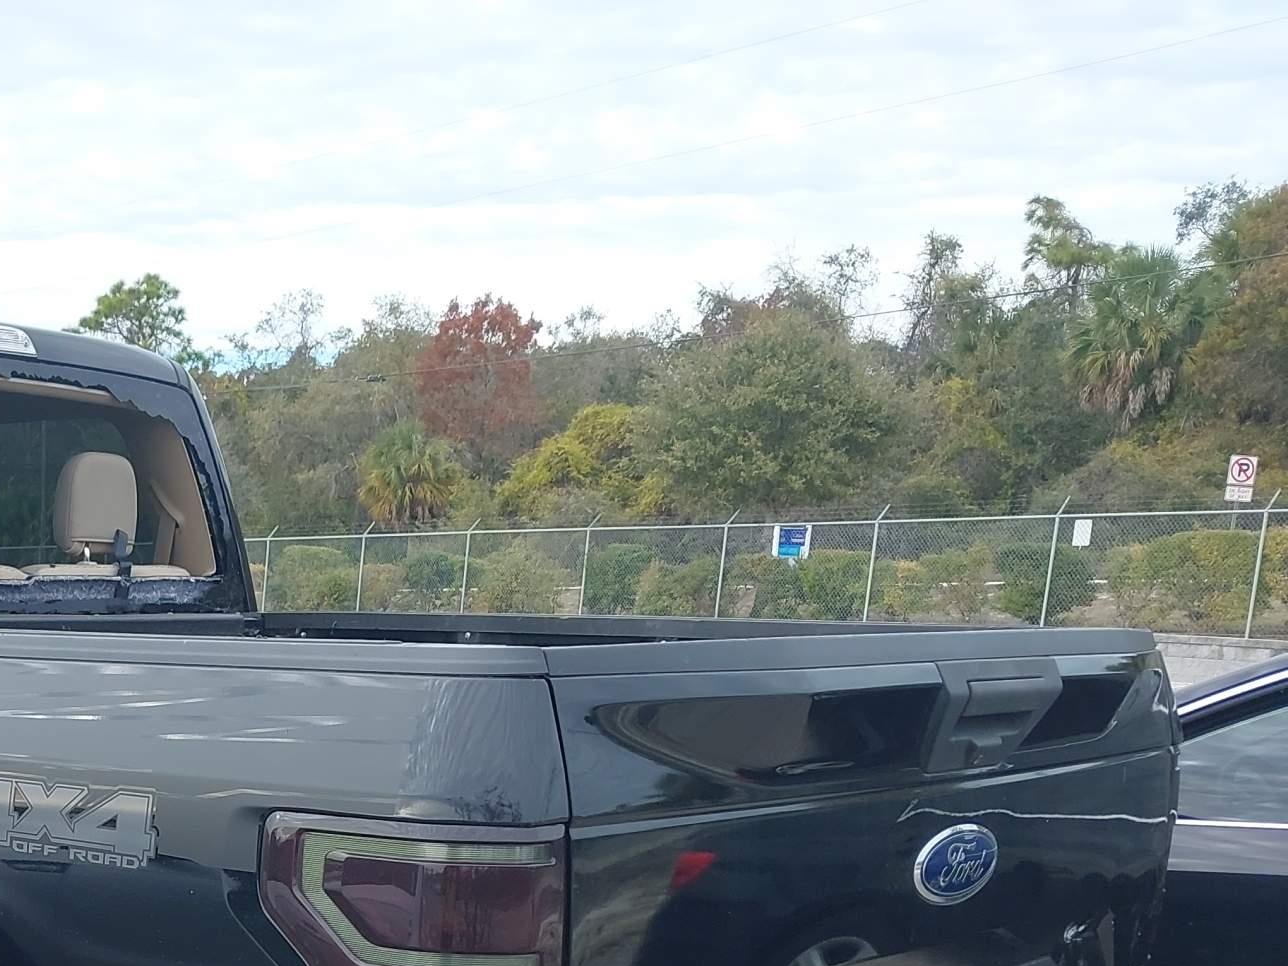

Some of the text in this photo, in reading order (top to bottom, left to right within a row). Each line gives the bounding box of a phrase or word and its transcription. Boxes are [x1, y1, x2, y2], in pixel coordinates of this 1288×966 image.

[12, 839, 141, 870] OFF ROAD
[939, 841, 986, 887] Ford
